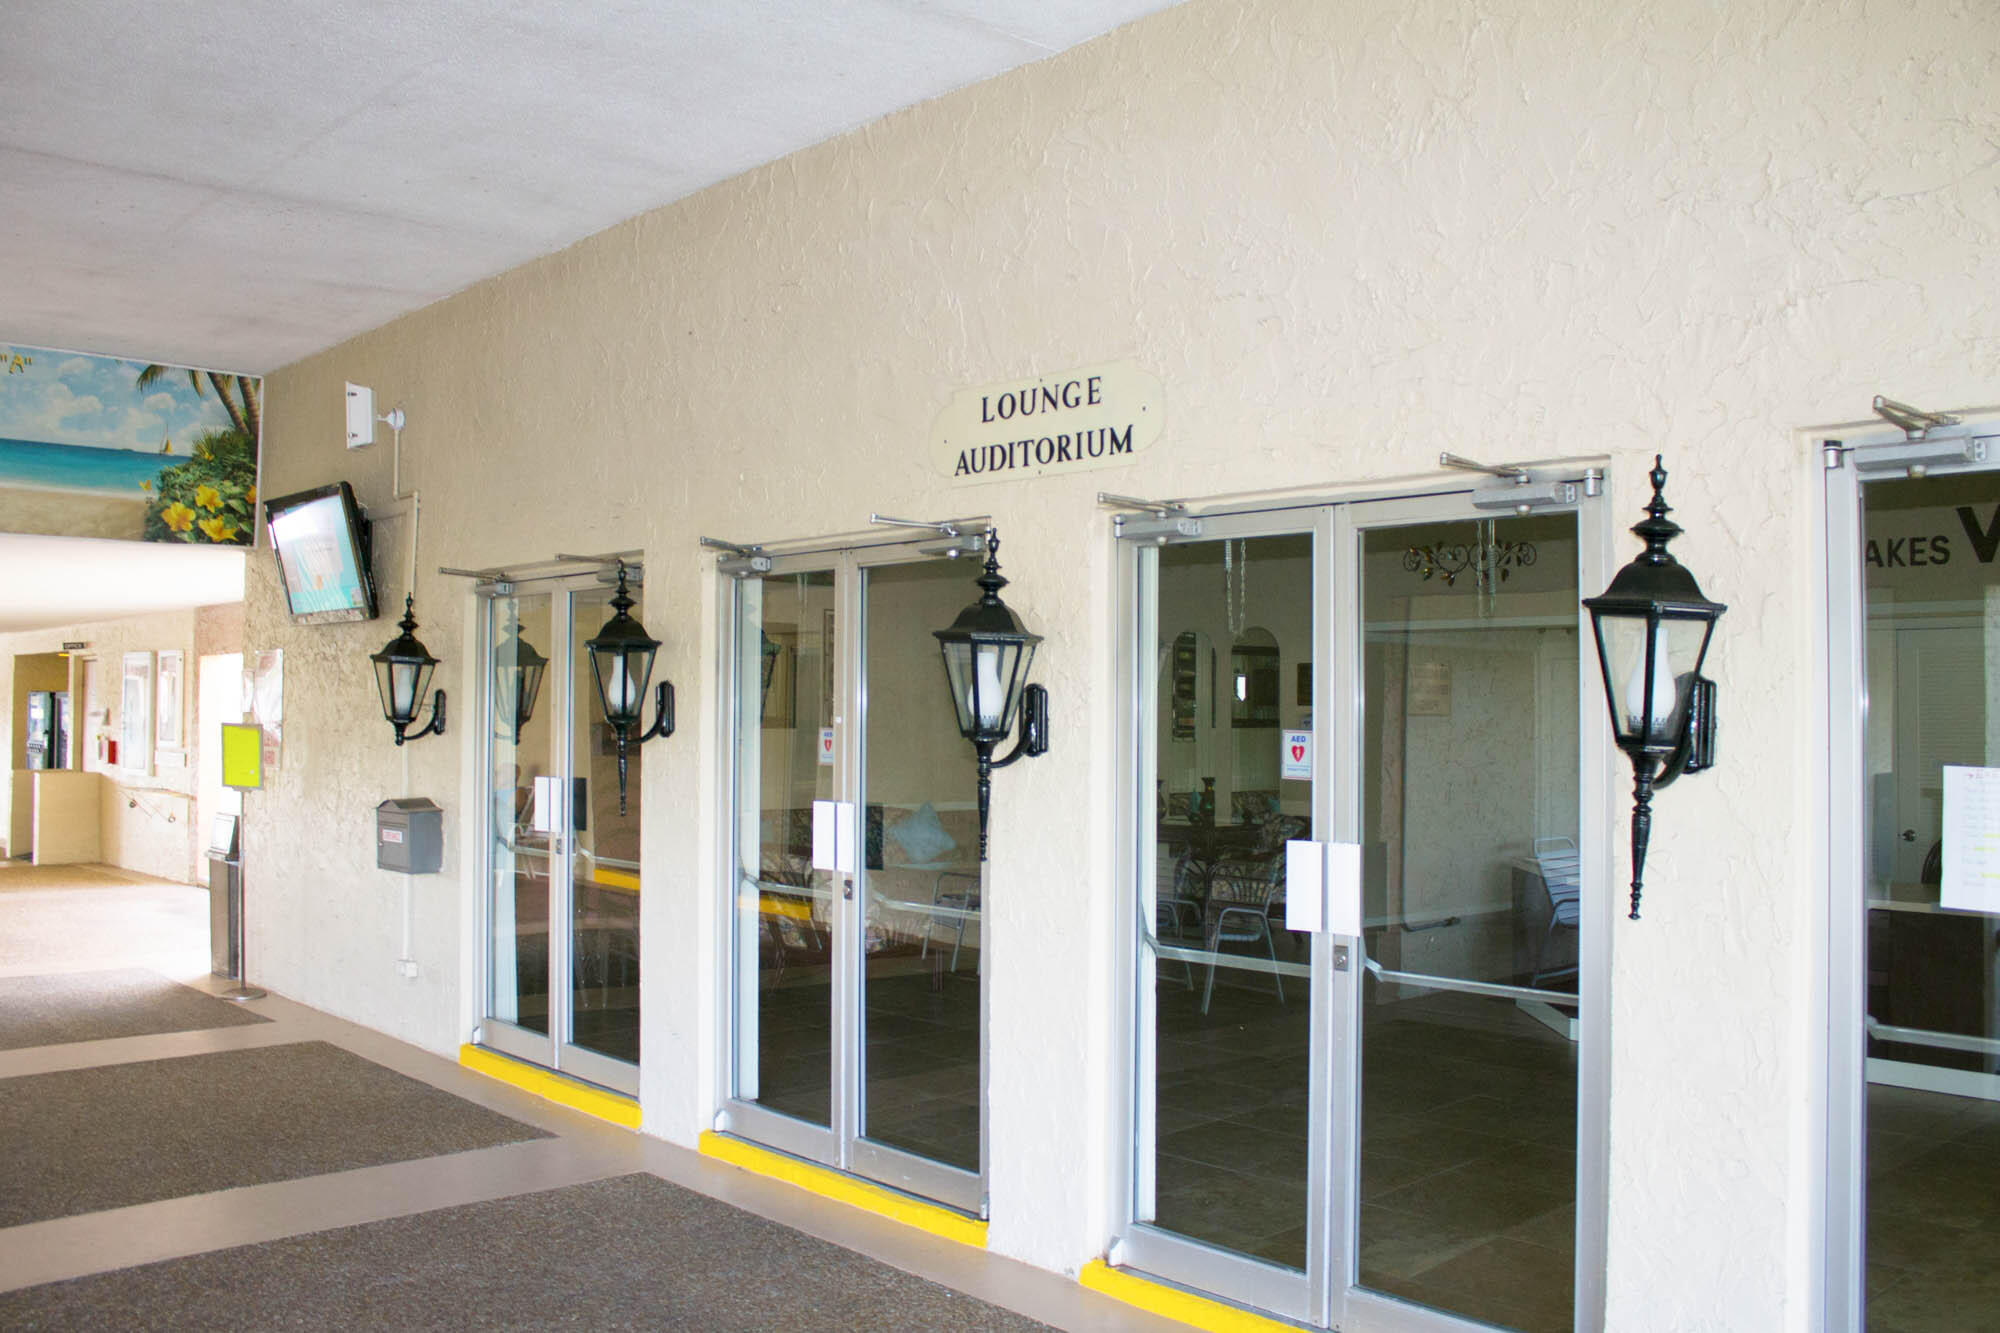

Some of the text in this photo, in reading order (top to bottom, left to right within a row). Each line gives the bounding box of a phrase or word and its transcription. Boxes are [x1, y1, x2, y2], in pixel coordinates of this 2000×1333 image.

[981, 376, 1102, 423] LOUNGE
[954, 424, 1134, 476] AUDITORIUM
[1291, 735, 1306, 743] AED
